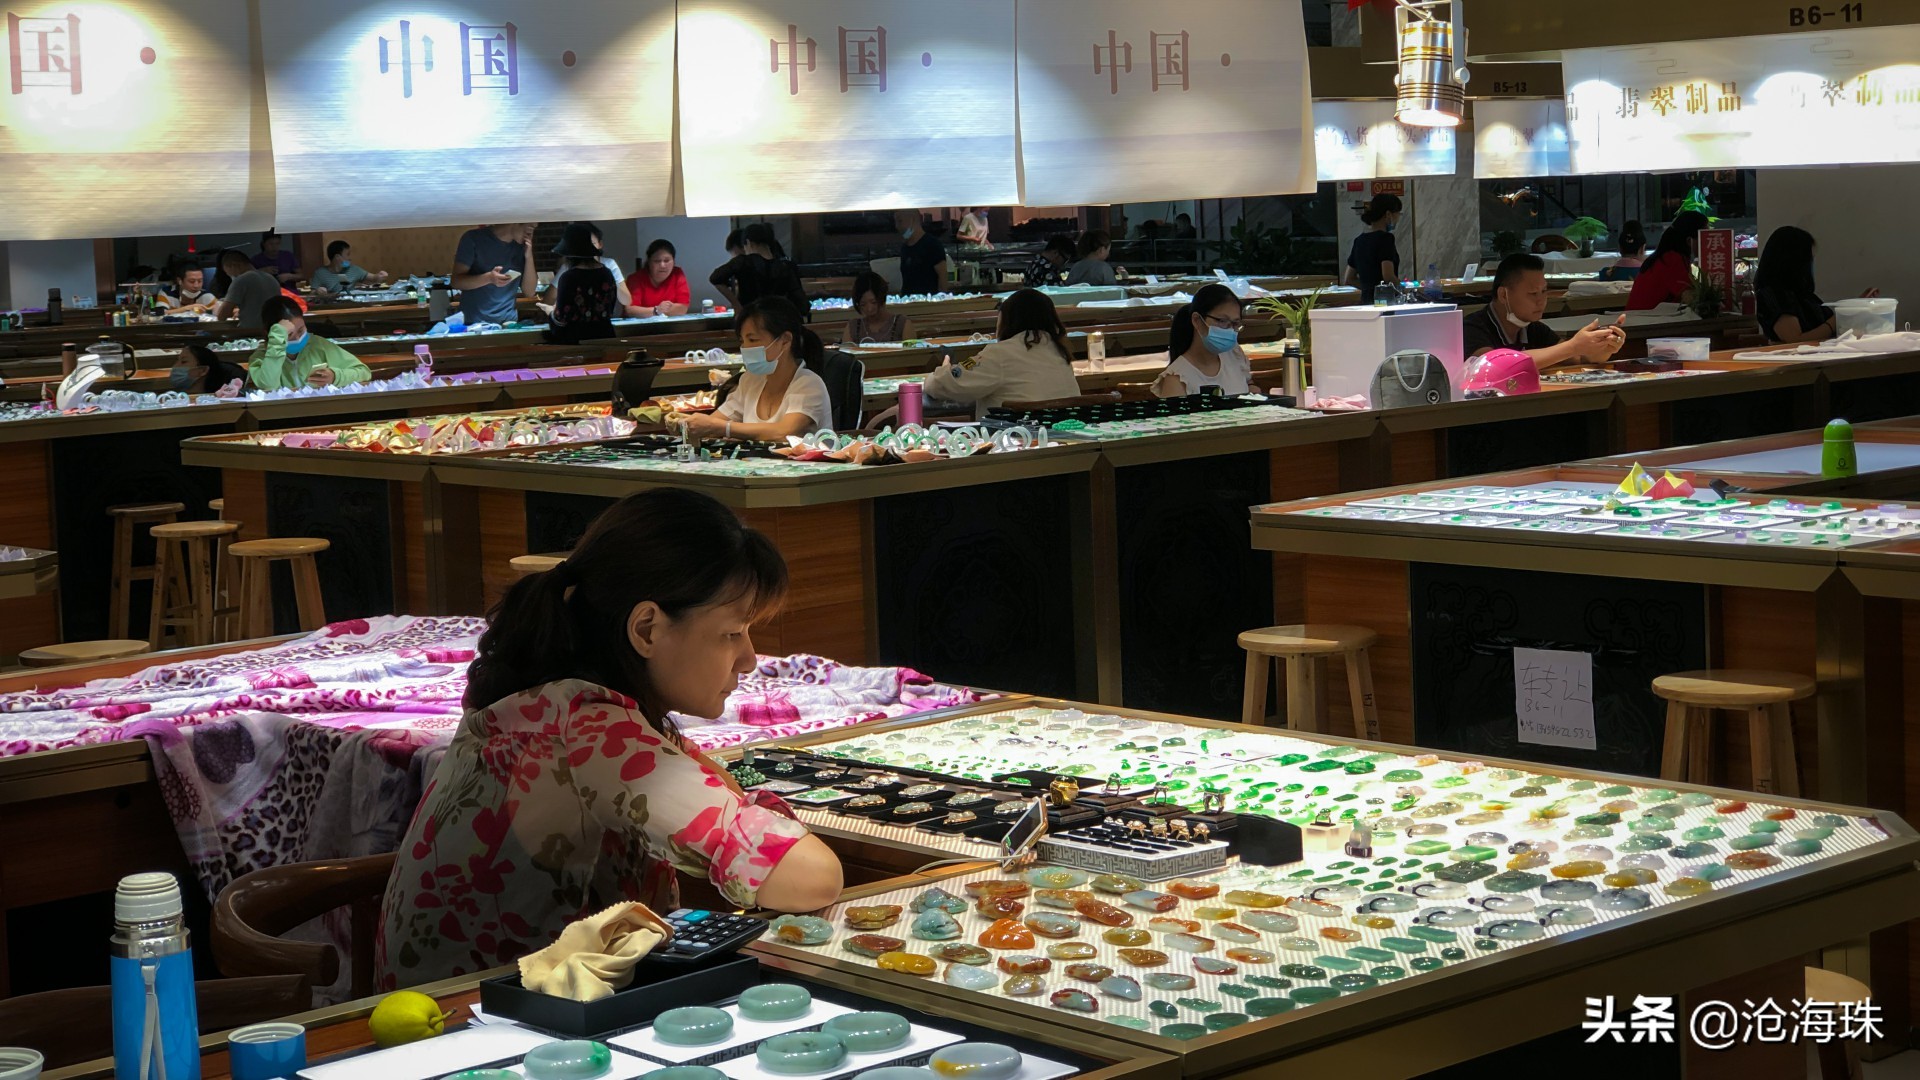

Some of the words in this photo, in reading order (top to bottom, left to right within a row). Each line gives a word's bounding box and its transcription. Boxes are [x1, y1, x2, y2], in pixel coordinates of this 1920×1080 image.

[1789, 3, 1863, 27] B6-11
[1493, 82, 1527, 93] B5-13
[1615, 81, 1742, 119] 翡翠制品
[1520, 662, 1591, 703] 转让
[1524, 698, 1563, 719] B6-11
